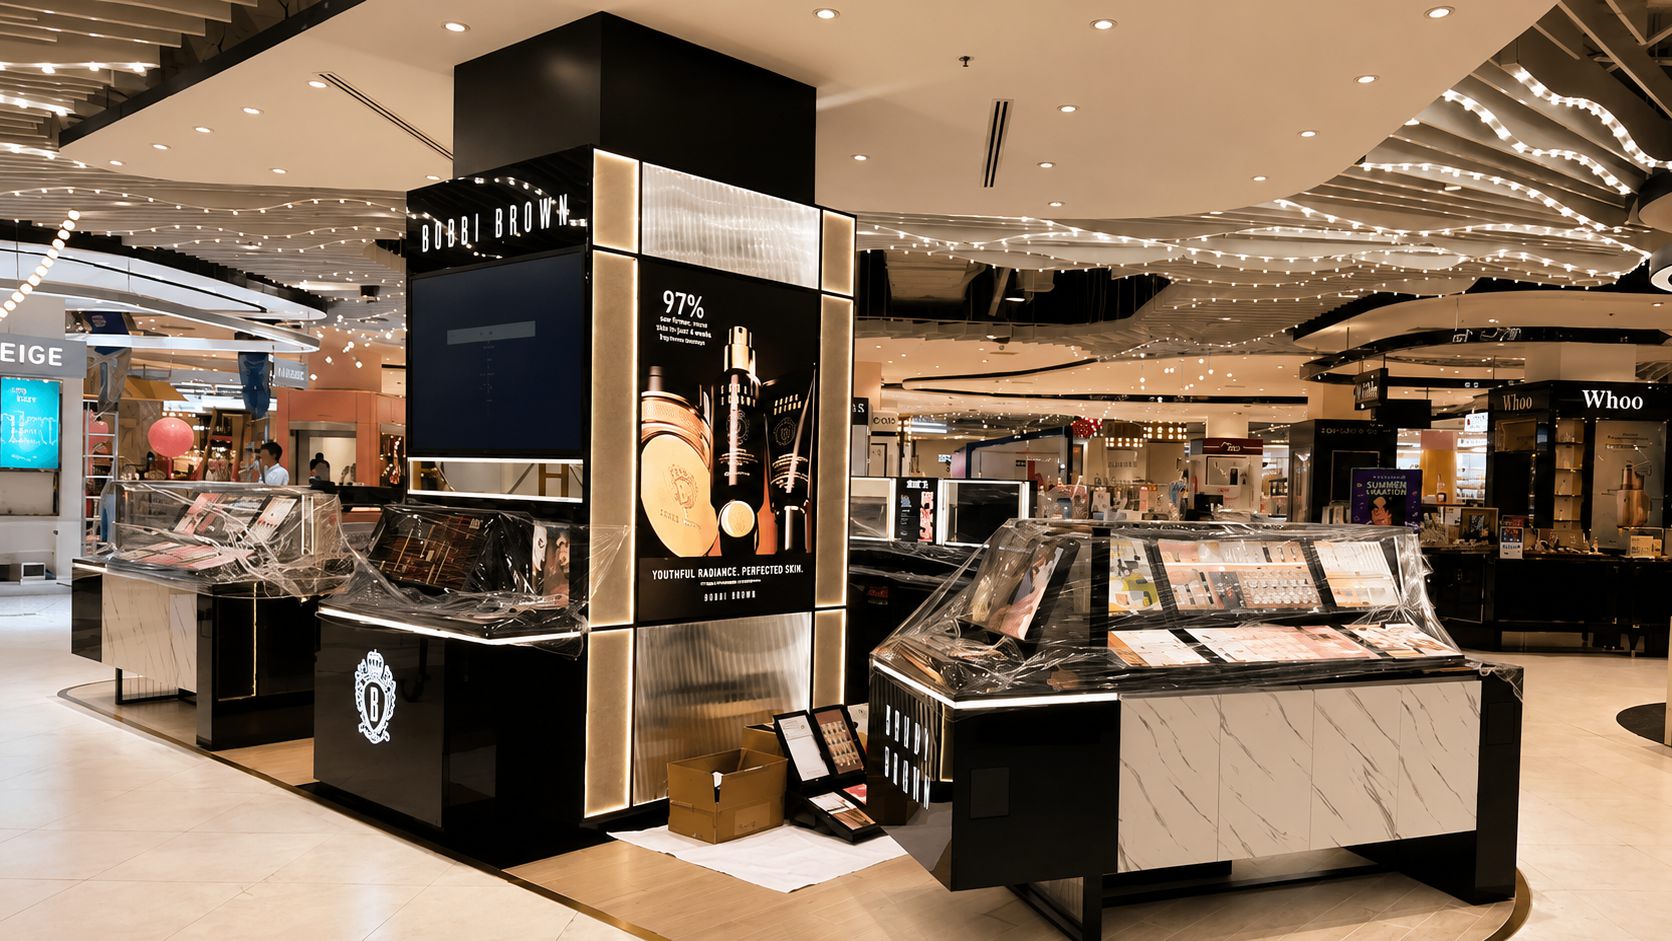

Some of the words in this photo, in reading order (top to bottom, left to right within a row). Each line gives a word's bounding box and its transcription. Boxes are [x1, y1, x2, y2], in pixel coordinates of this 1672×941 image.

[421, 212, 479, 253] BOBBI
[495, 193, 569, 238] BROWN
[663, 290, 704, 318] 97%
[1502, 394, 1533, 411] Whoo
[1582, 389, 1644, 410] Whoo
[652, 569, 696, 580] YOUTHFUL
[697, 566, 740, 578] RADIANCE.
[741, 564, 783, 576] PERFECTED
[785, 564, 804, 574] SKIN.
